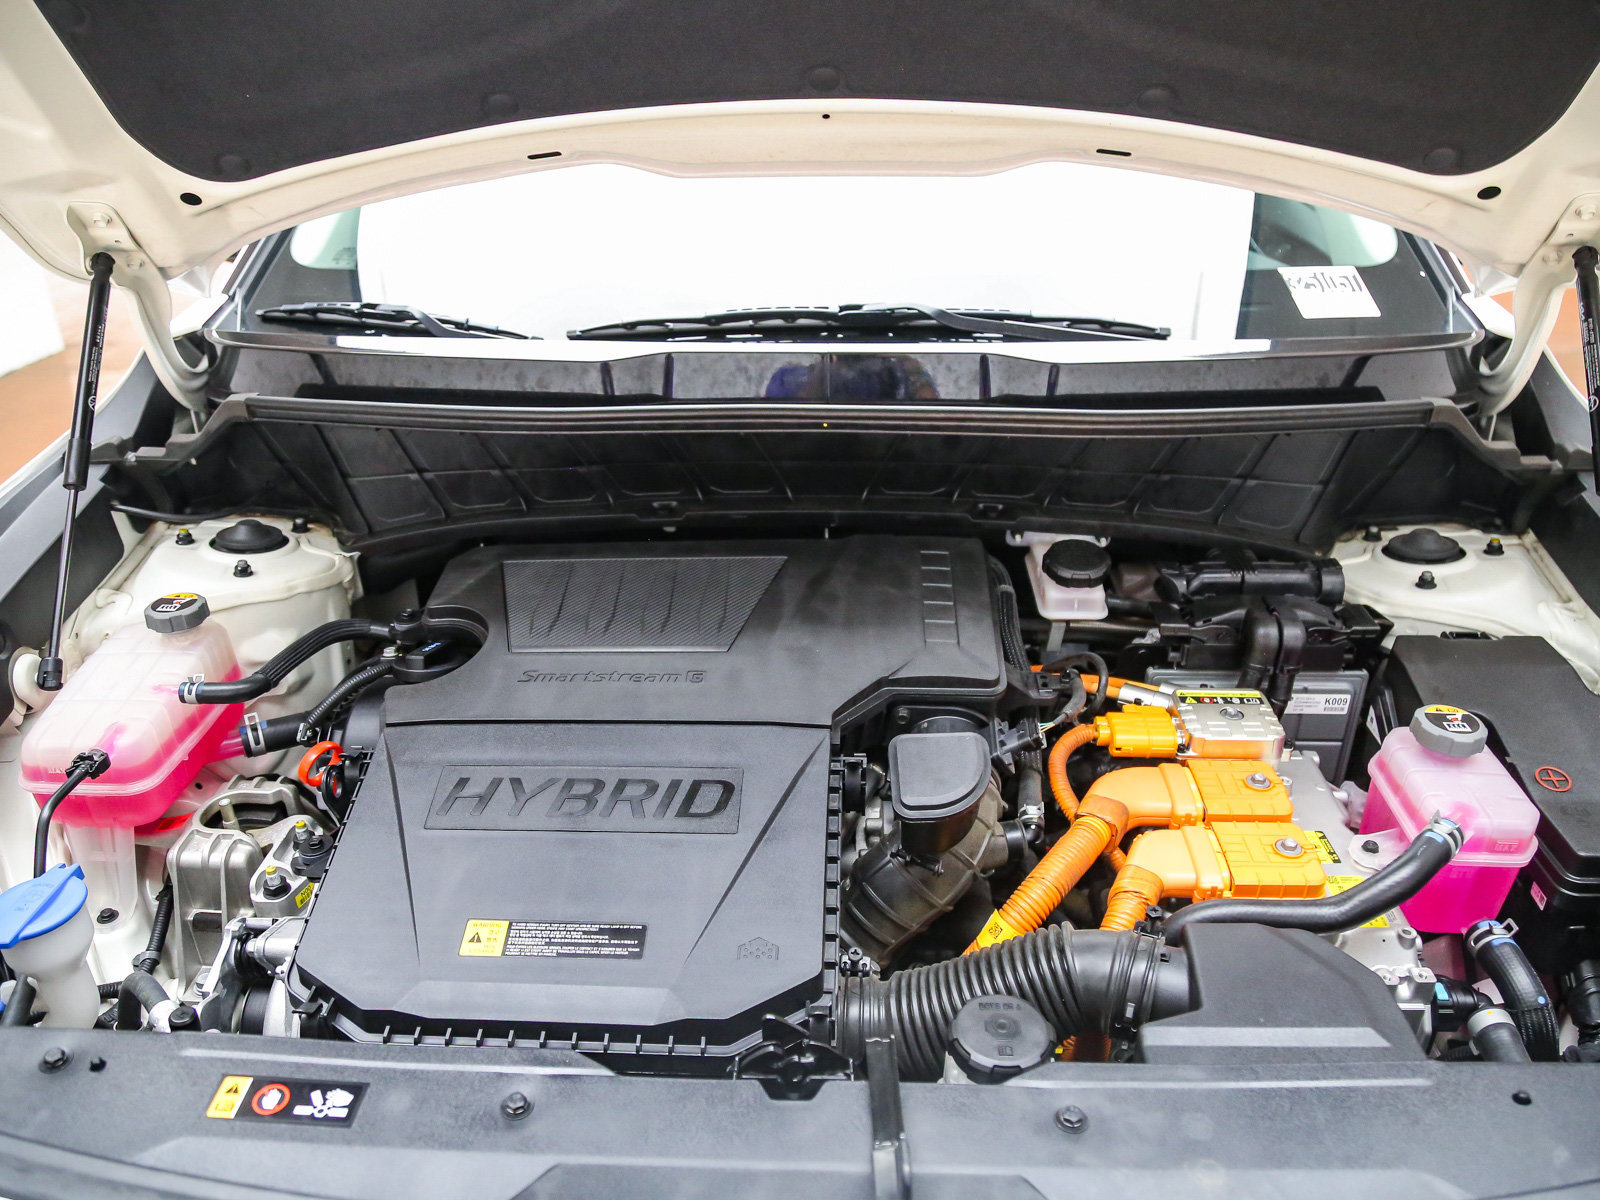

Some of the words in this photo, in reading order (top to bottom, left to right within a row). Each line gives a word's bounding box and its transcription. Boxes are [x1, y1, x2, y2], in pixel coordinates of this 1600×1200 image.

[516, 669, 682, 684] Smartstream
[1324, 697, 1348, 706] K009
[435, 776, 736, 819] HYBRID
